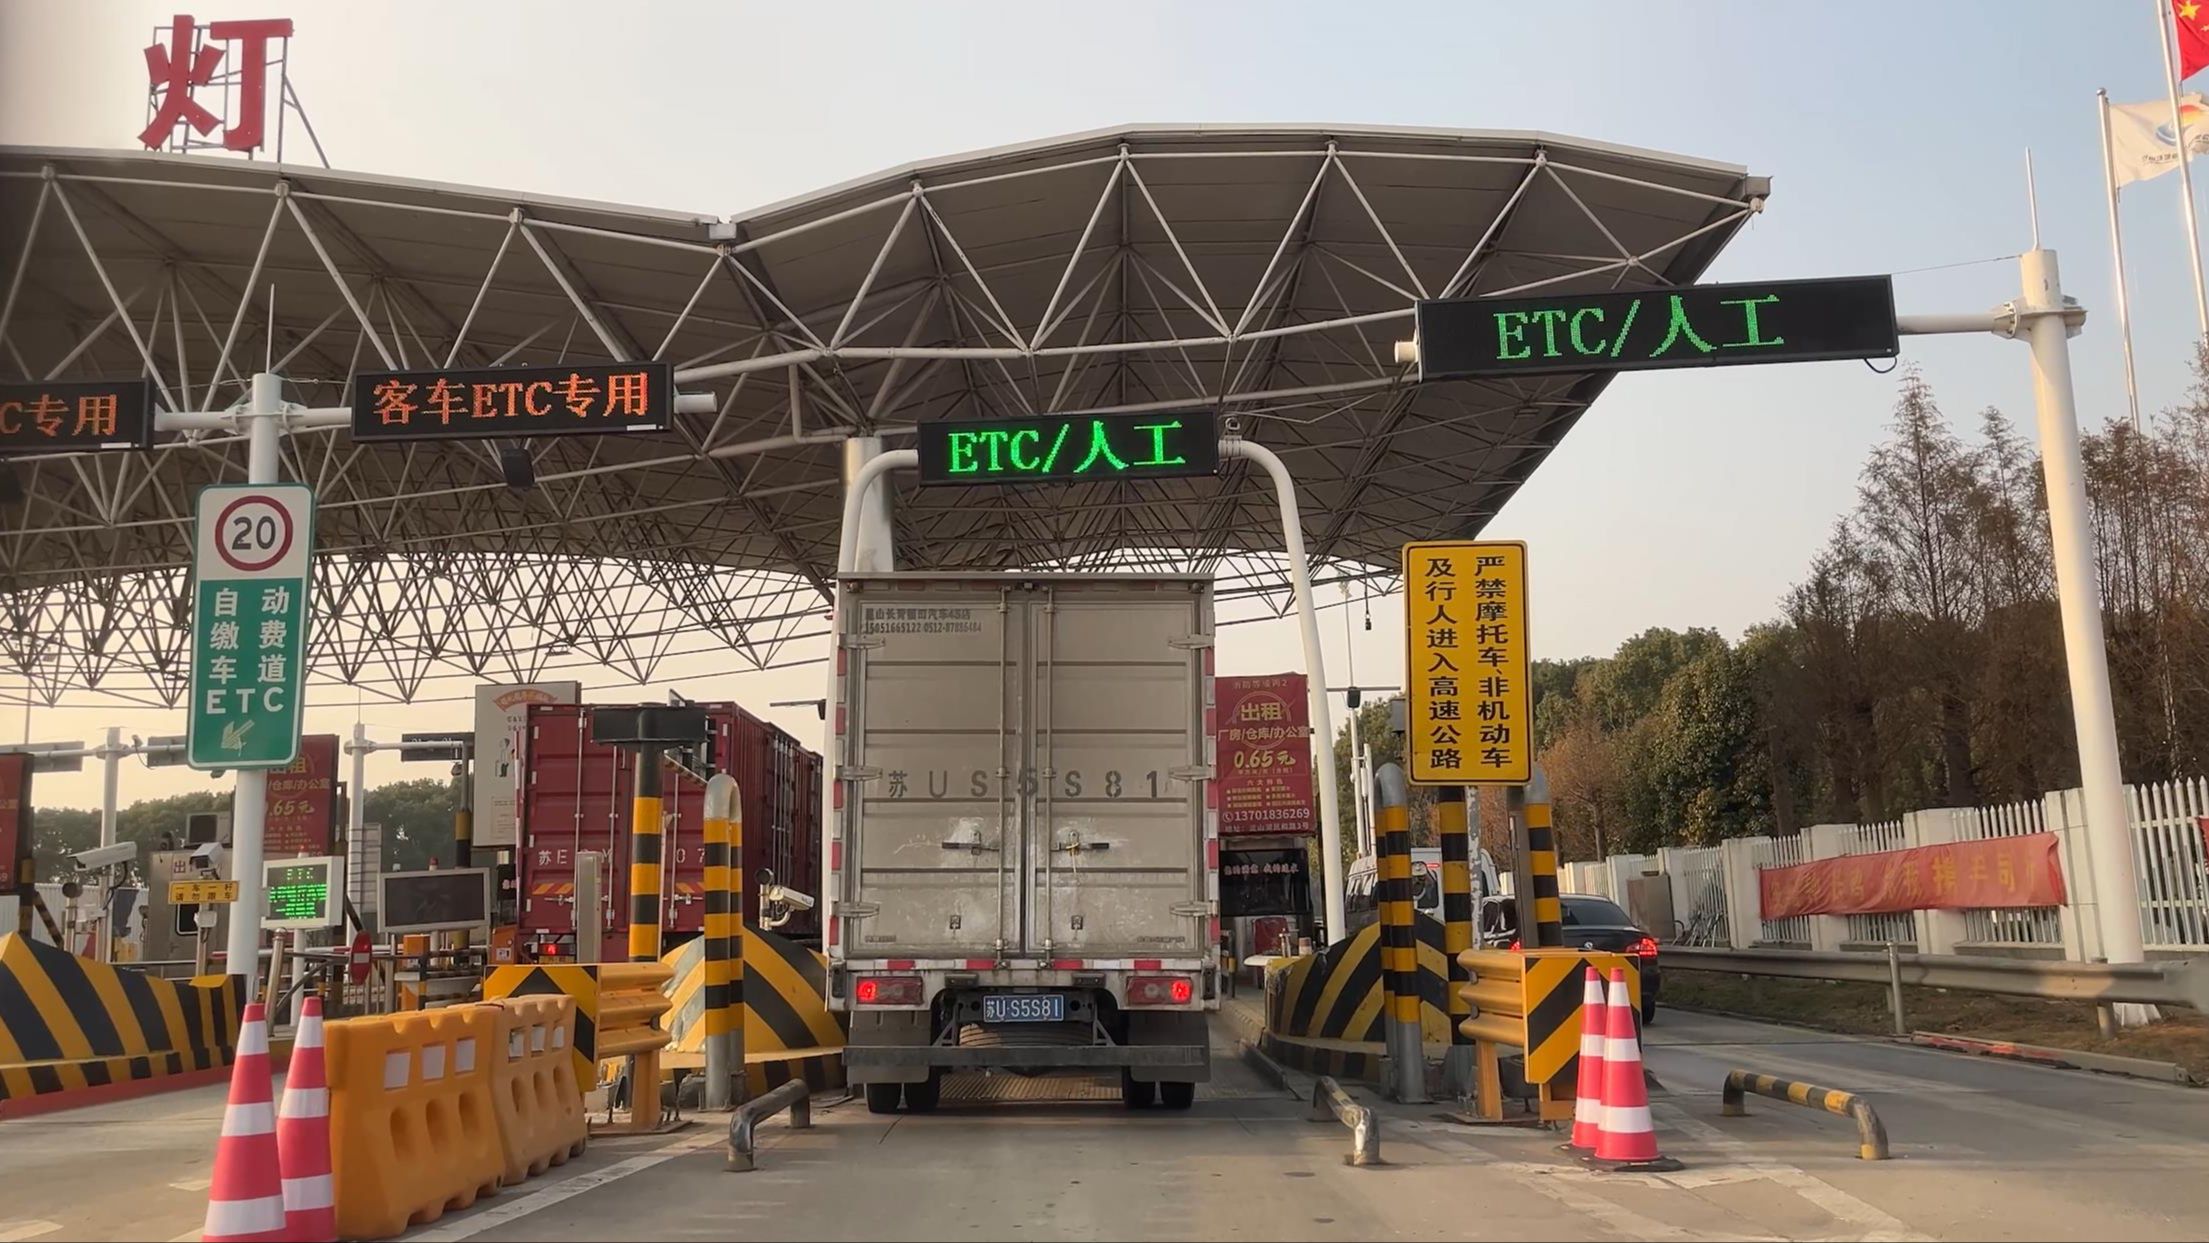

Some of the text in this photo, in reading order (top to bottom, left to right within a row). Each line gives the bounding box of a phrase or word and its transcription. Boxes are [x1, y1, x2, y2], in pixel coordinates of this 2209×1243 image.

[137, 14, 293, 152] 灯
[1493, 294, 1785, 360] ETC/人工
[373, 372, 649, 425] 客车ETC专用
[948, 420, 1186, 473] ETC/人工
[231, 515, 277, 551] 20
[213, 585, 291, 617] 自动
[209, 620, 288, 651] 缴费
[208, 654, 287, 685] 车道
[1424, 557, 1463, 769] 及行人进入高速公路
[205, 687, 285, 715] ETC
[1241, 702, 1282, 721] 出租
[1235, 807, 1310, 822] 13701836269
